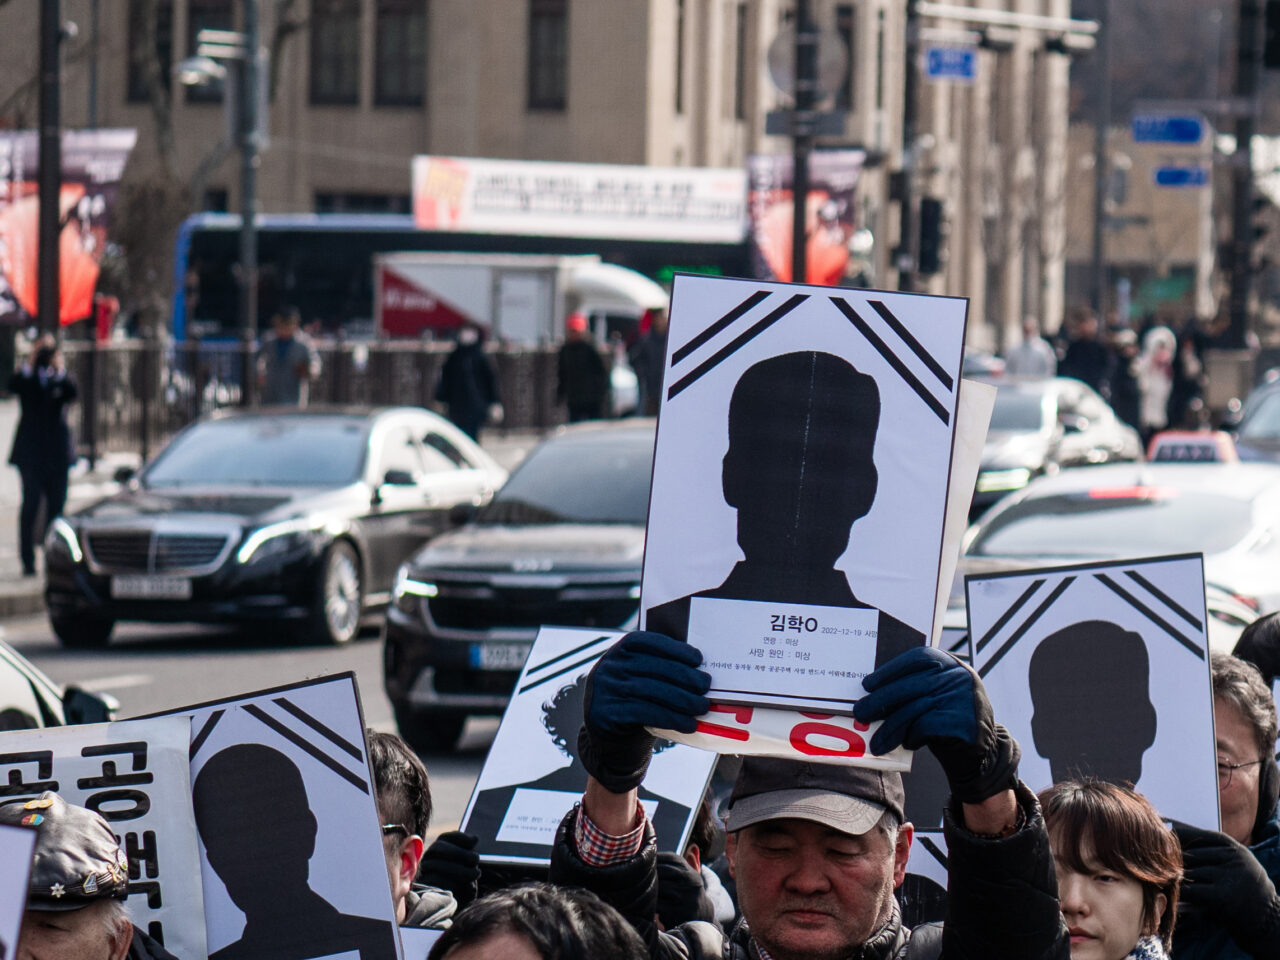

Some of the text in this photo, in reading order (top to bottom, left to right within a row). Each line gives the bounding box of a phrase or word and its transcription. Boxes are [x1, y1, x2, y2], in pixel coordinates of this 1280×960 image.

[770, 614, 818, 634] 김학O
[749, 648, 765, 658] 사망
[769, 649, 784, 659] 원인
[795, 650, 811, 661] 미상
